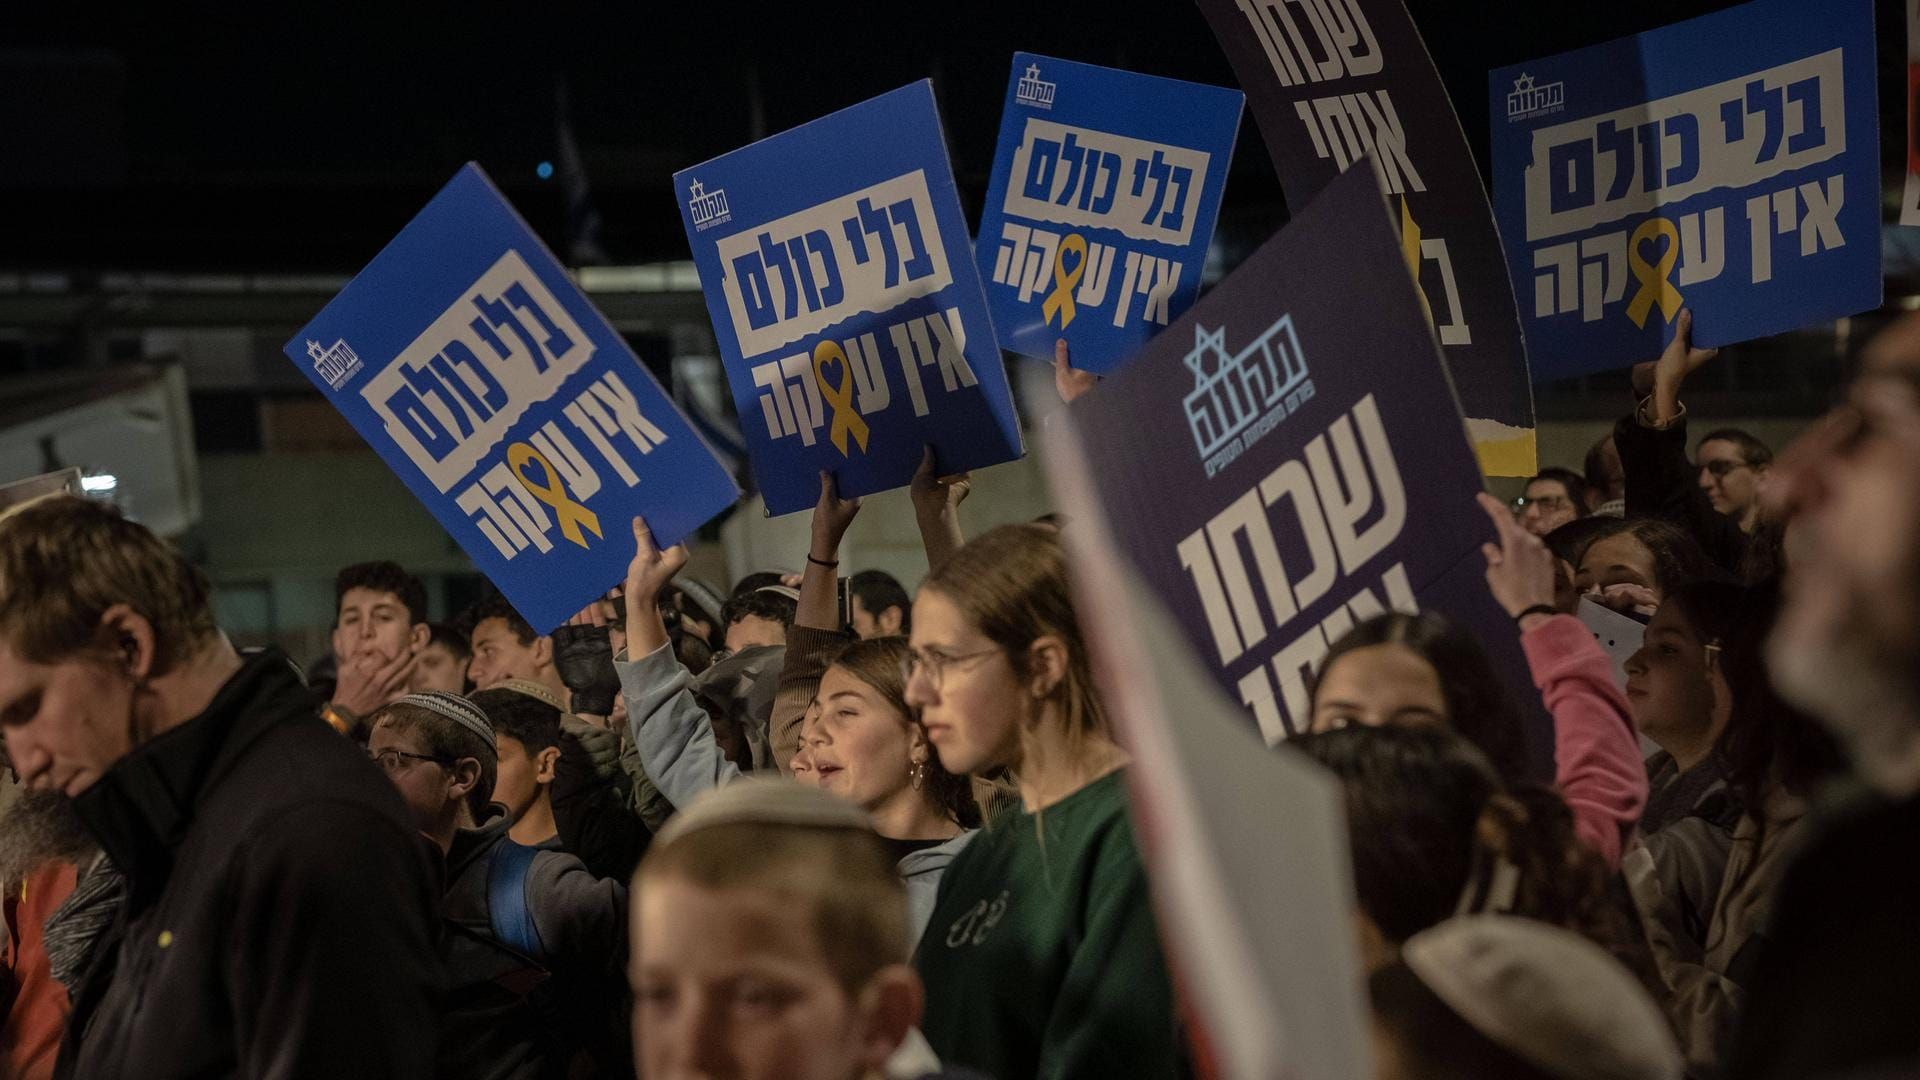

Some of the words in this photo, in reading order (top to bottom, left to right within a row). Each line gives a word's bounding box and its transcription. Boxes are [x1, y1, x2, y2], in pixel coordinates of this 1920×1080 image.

[1016, 77, 1056, 104] תקווה
[1235, 0, 1384, 87] שכחו
[1508, 81, 1564, 115] תקווה
[1720, 75, 1826, 165] בלי
[689, 188, 730, 224] תקווה
[1022, 132, 1122, 215] כולם
[1131, 150, 1193, 232] בלי
[1549, 112, 1700, 215] כולם
[842, 197, 935, 289] בלי
[1746, 173, 1846, 284] אין
[732, 228, 846, 331] כולם
[1112, 250, 1183, 328] אין
[469, 280, 575, 376] בלי
[888, 307, 979, 417] אין
[385, 361, 510, 464] כולם
[562, 370, 669, 488] אין
[1183, 312, 1309, 460] תקווה
[1176, 392, 1407, 667] שכחו
